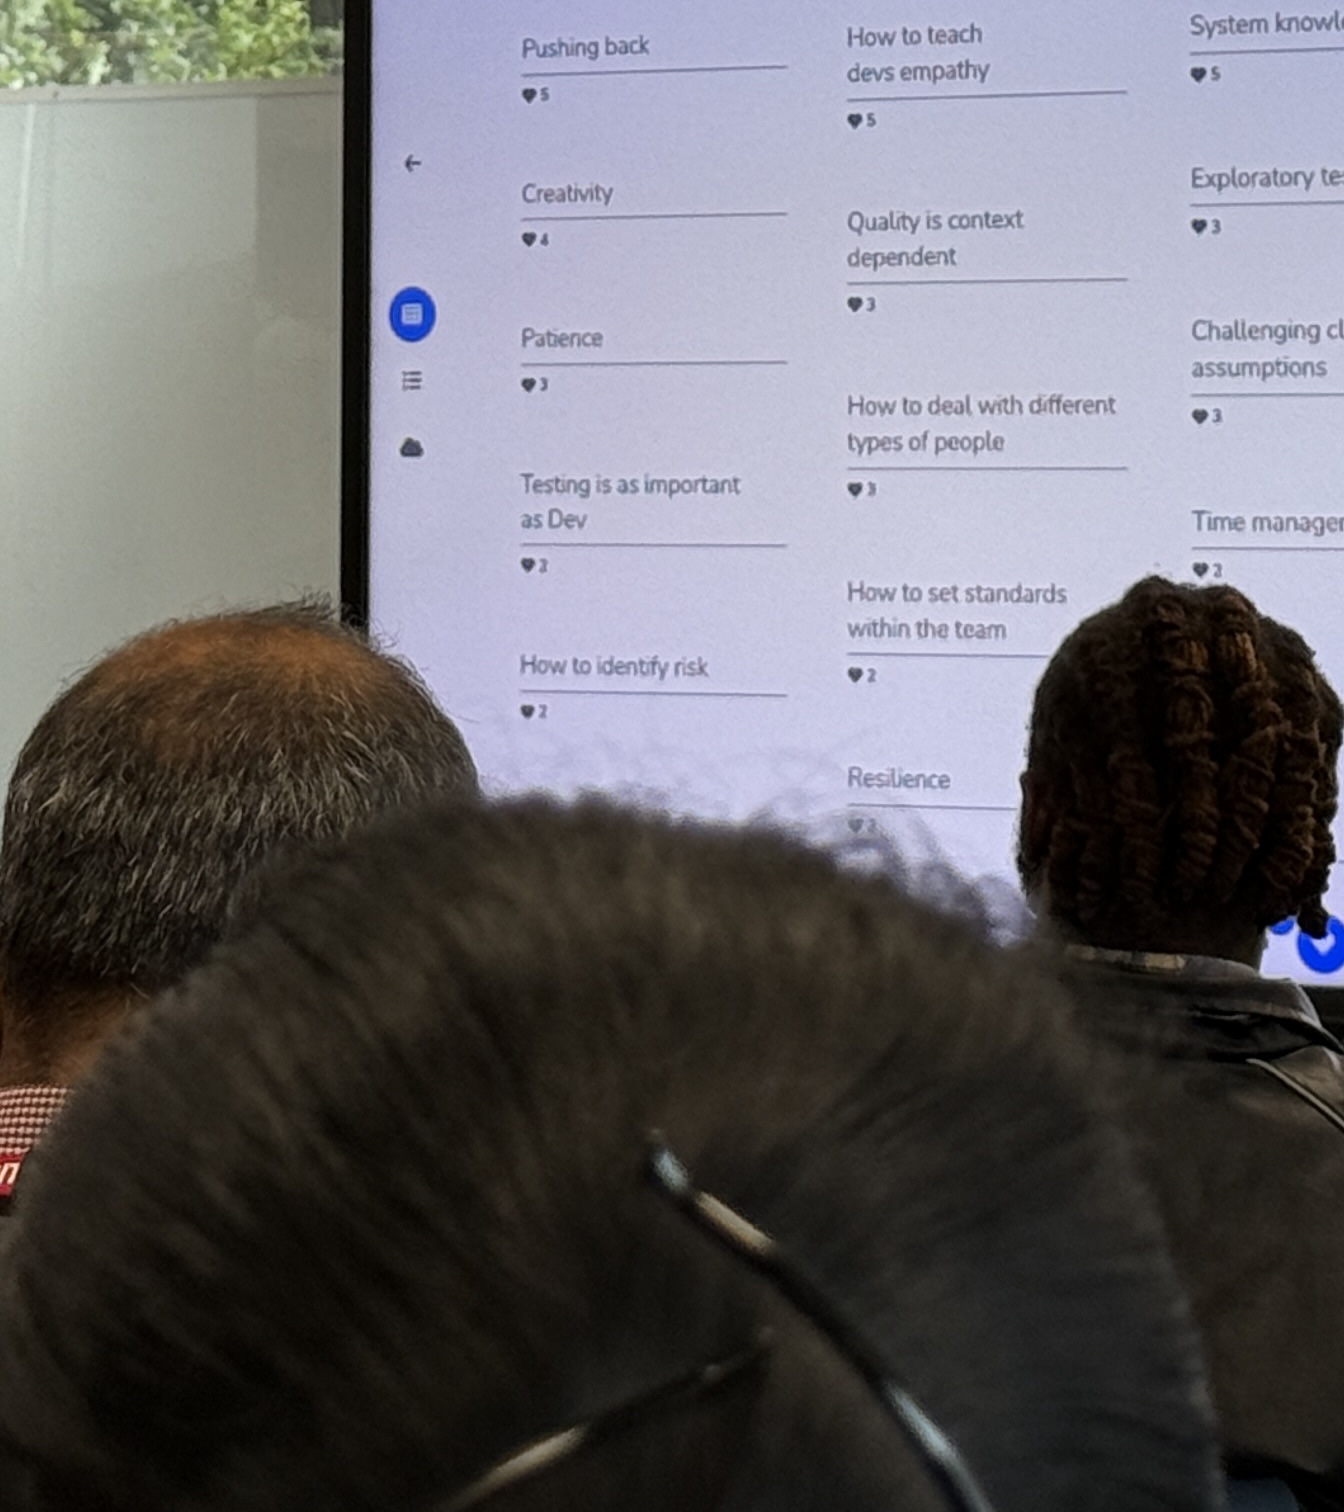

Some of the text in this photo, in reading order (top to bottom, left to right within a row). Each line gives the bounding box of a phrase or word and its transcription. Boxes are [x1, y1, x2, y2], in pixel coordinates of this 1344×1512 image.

[847, 22, 983, 49] How to teach
[1190, 13, 1269, 41] System
[521, 34, 650, 62] Pushing back
[846, 58, 991, 86] devs empathy
[1191, 165, 1316, 193] Exploratory
[521, 182, 614, 207] Creativity
[847, 209, 1025, 237] Quality is context
[846, 245, 958, 273] dependent
[521, 326, 604, 349] Patience
[1191, 318, 1321, 346] Challenging
[1191, 355, 1328, 383] assumptions
[847, 393, 1117, 417] How to deal with different
[847, 429, 1006, 457] types of people
[519, 472, 742, 500] Testing is as important
[520, 507, 588, 530] as Dev
[1191, 509, 1246, 533] Time
[847, 580, 1068, 605] How to set standards
[847, 616, 1007, 640] within the team
[519, 653, 710, 682] How to identify risk
[847, 765, 951, 790] Resilience
